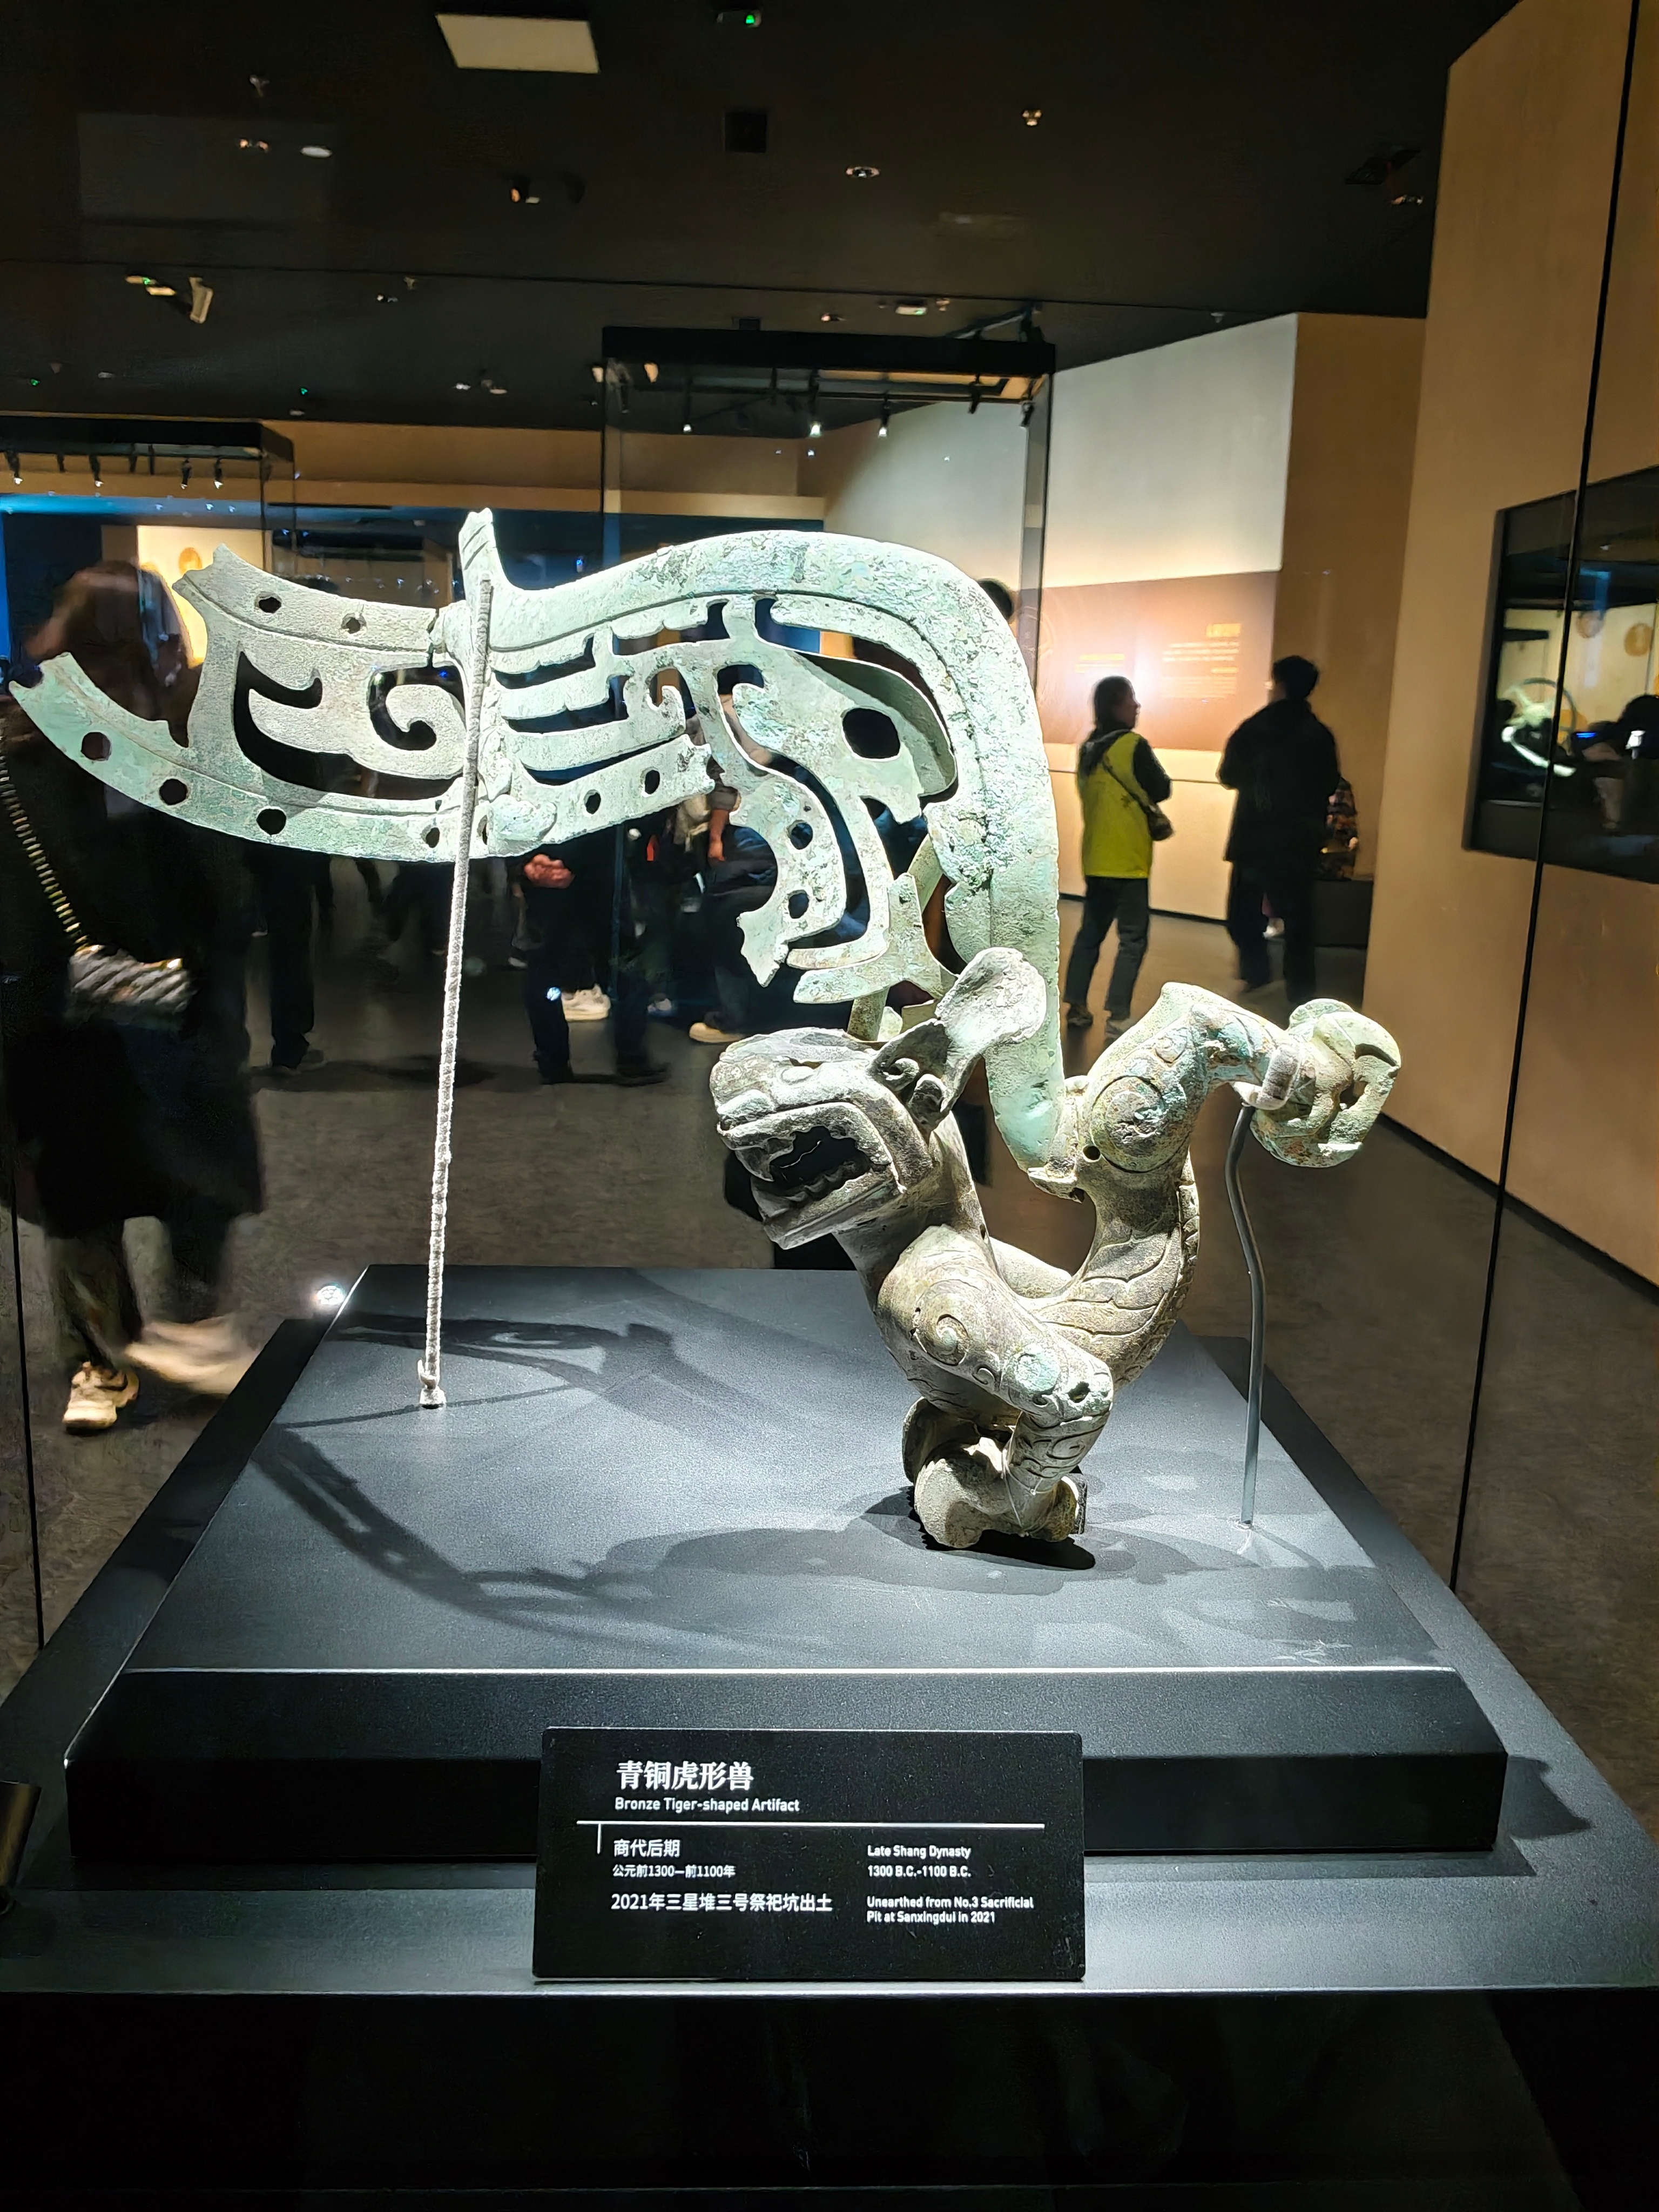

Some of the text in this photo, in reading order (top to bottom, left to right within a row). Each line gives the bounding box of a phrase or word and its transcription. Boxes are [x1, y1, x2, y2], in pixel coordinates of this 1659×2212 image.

[616, 1761, 754, 1791] 青铜虎形兽
[615, 1797, 800, 1814] Bronze Tiger-shaped Artifact
[614, 1839, 680, 1857] 商代后期
[868, 1845, 971, 1859] Late Shang Dynasty
[868, 1865, 971, 1877] 1300 B.C.-1100 B.C.
[611, 1893, 833, 1912] 2021年三星堆三号祭祀坑出土
[867, 1896, 1034, 1908] Unearthed from No.3 Sacrificial
[867, 1911, 995, 1925] Pit at Sanxingdui in 2021
